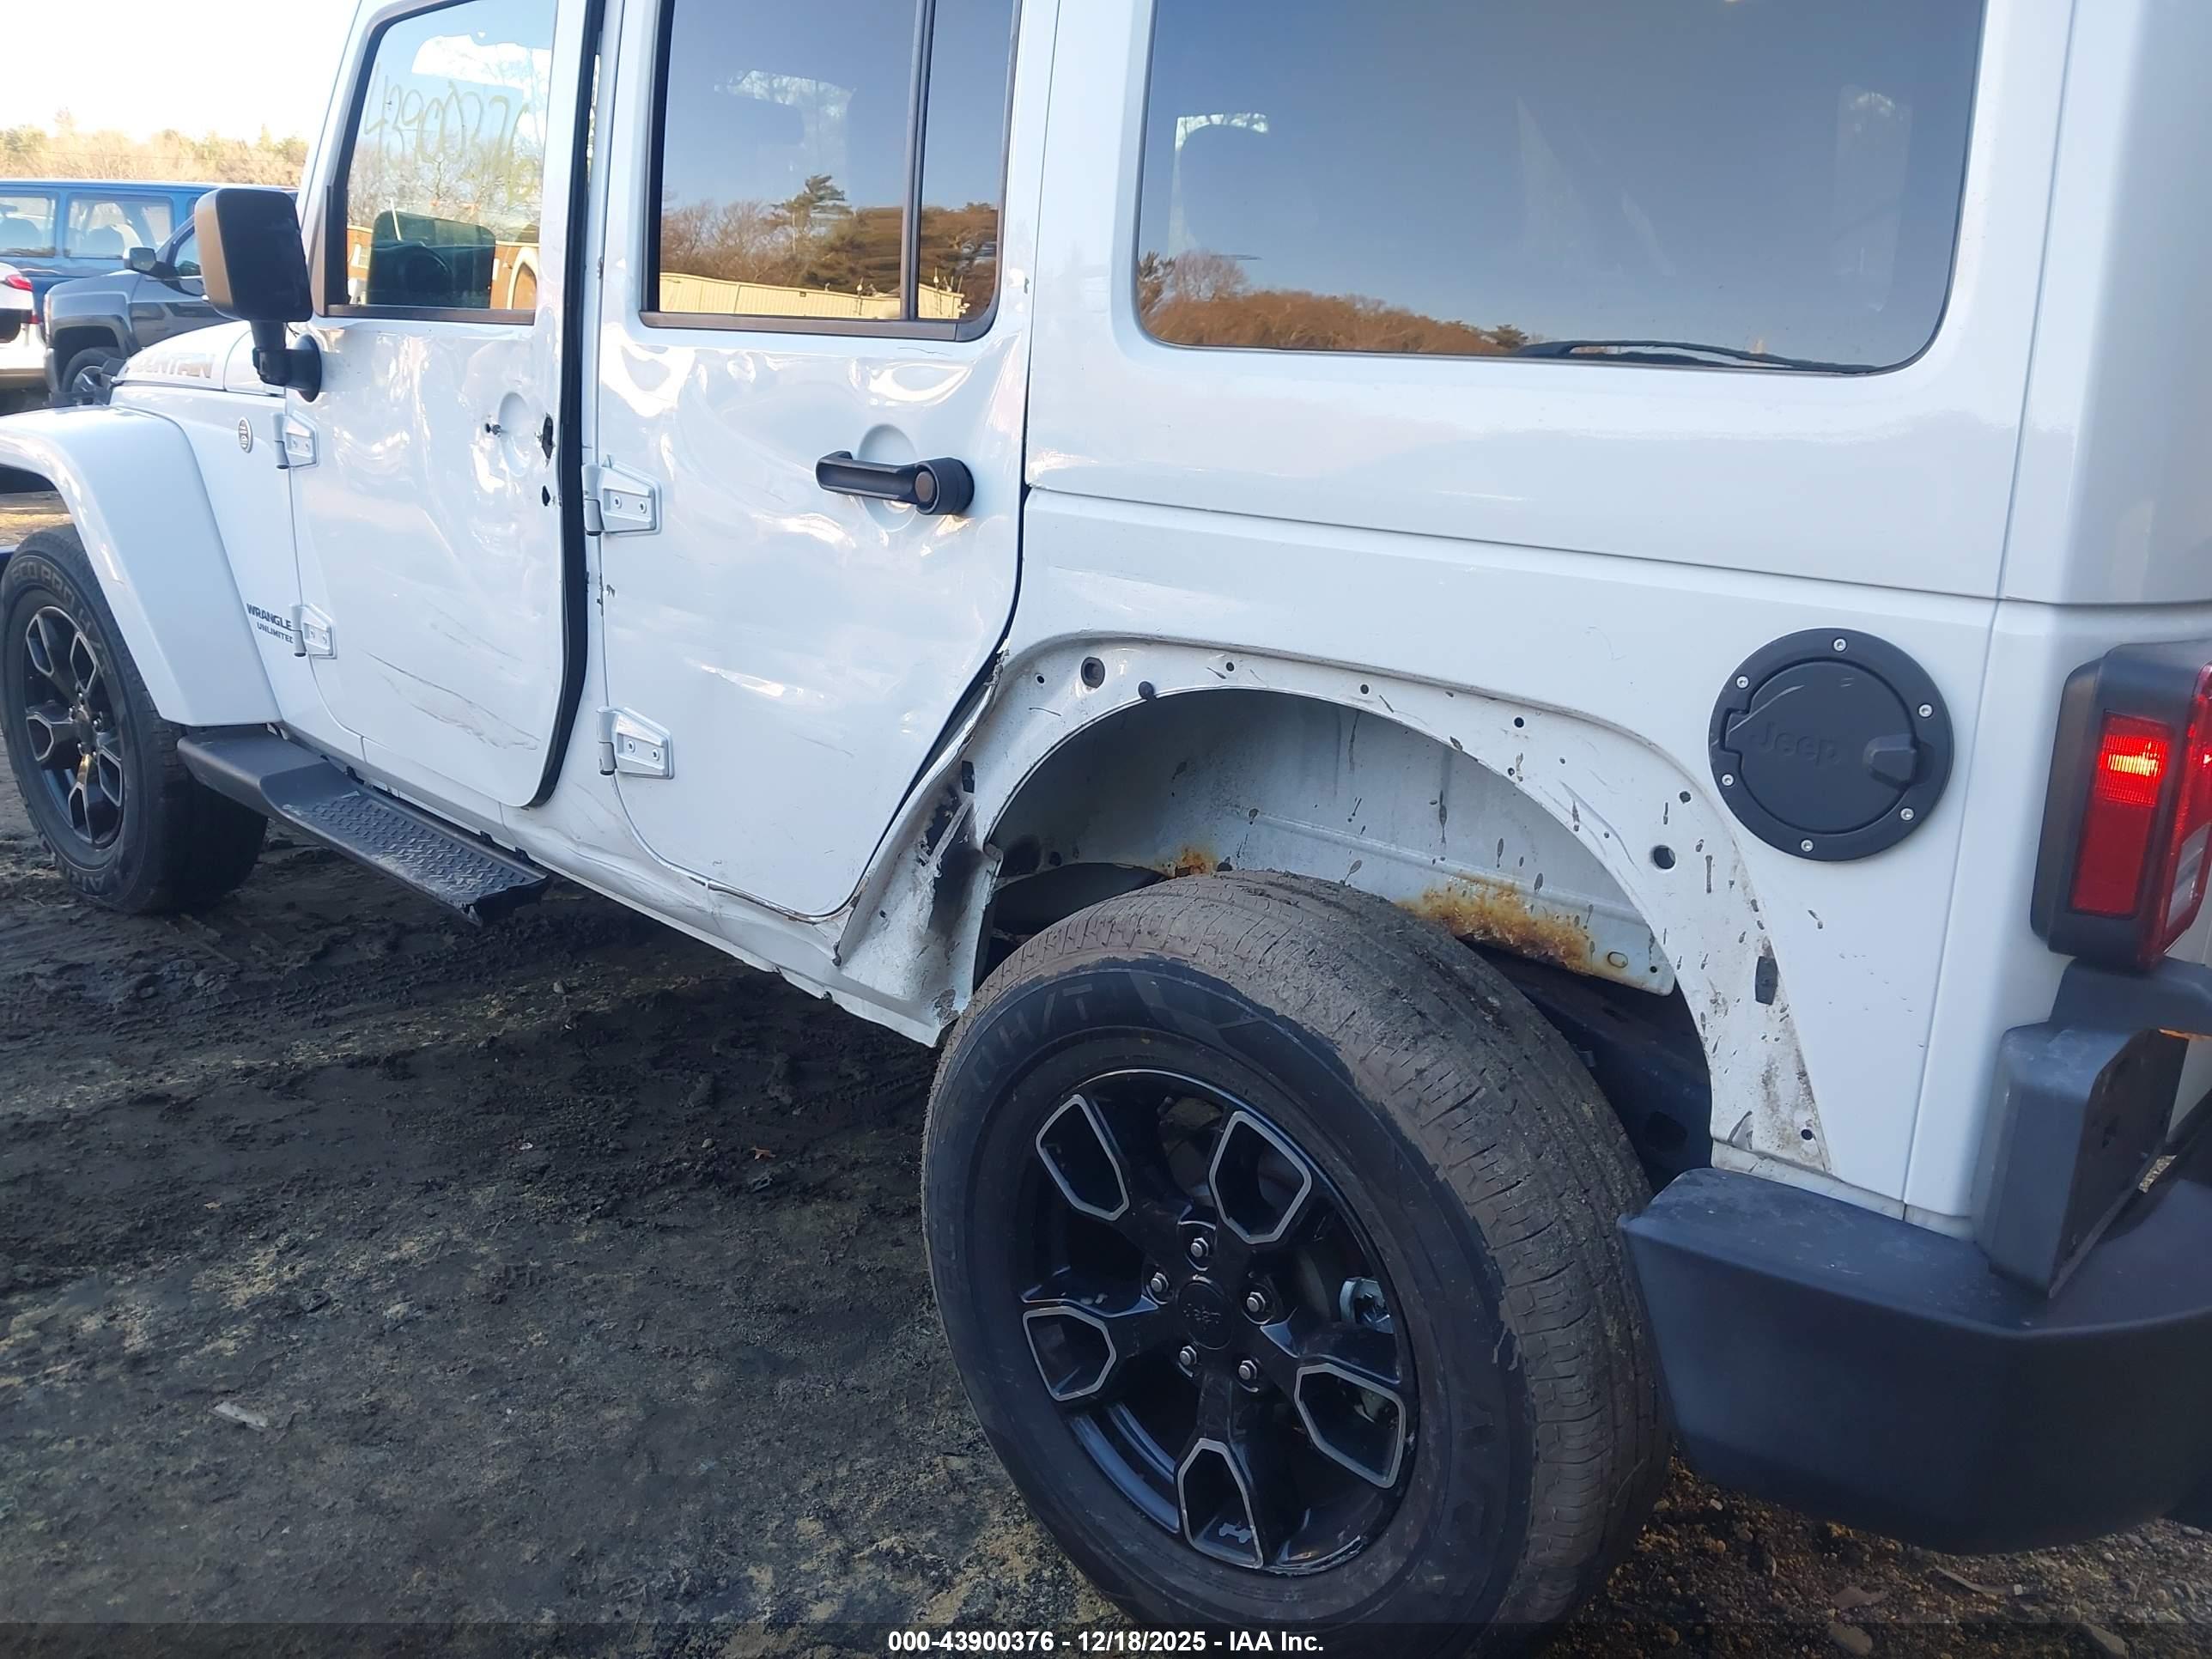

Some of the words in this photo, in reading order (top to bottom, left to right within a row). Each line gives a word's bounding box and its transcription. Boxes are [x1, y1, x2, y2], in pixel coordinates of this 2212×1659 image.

[11, 561, 38, 586] ECO
[246, 603, 293, 629] WRANGLE
[1750, 720, 1841, 769] Jeep
